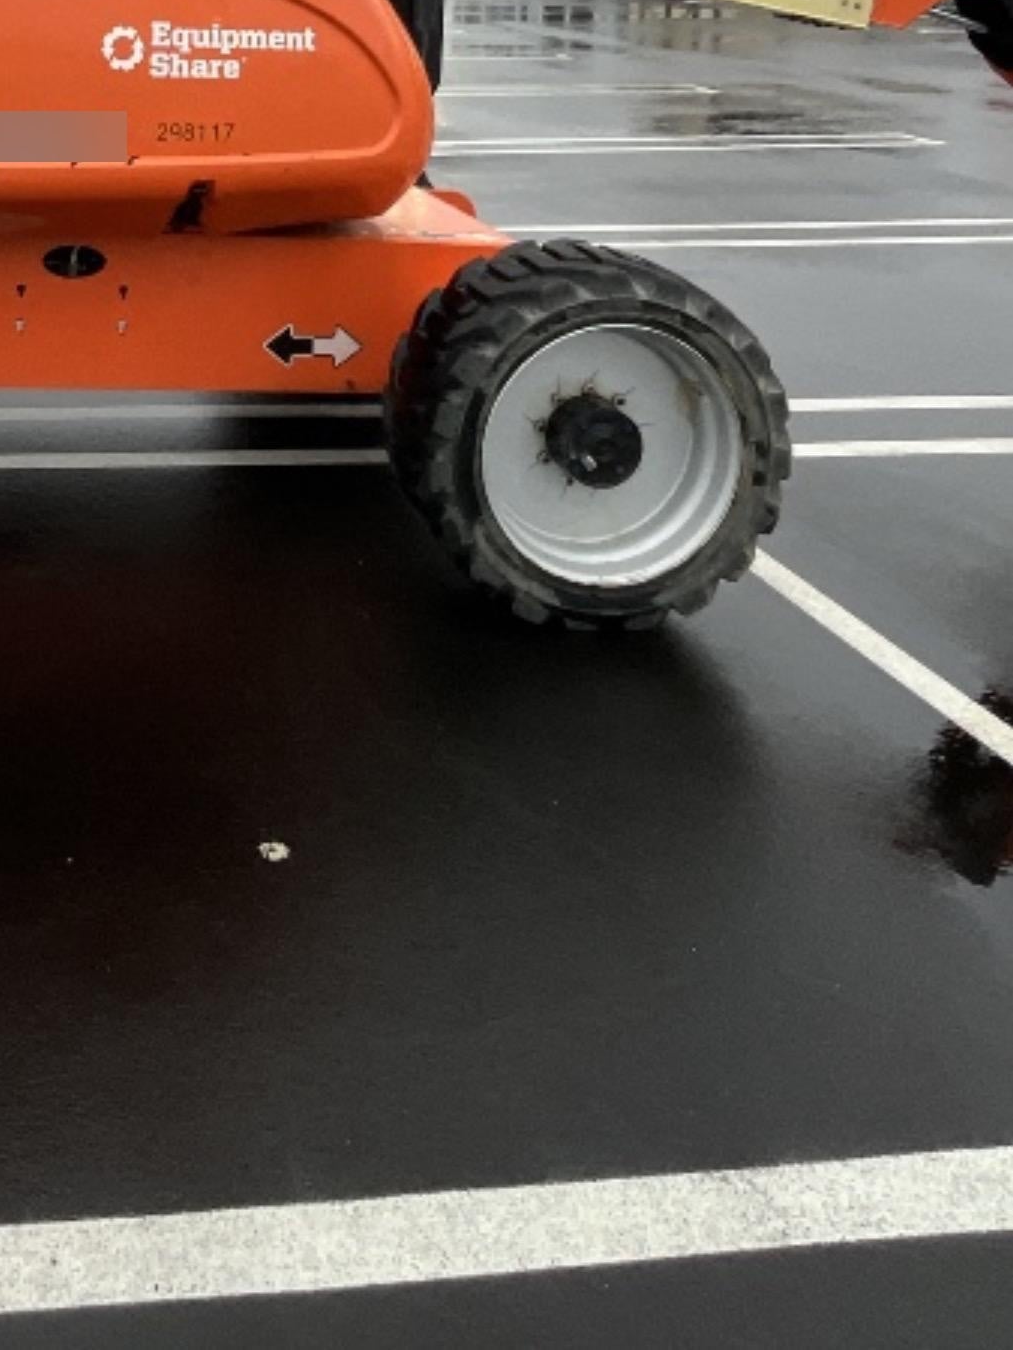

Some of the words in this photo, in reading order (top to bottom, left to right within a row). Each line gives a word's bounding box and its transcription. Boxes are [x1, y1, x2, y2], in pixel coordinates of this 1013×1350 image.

[150, 20, 316, 54] Equipment
[149, 52, 241, 79] Share
[157, 122, 236, 142] 298117
